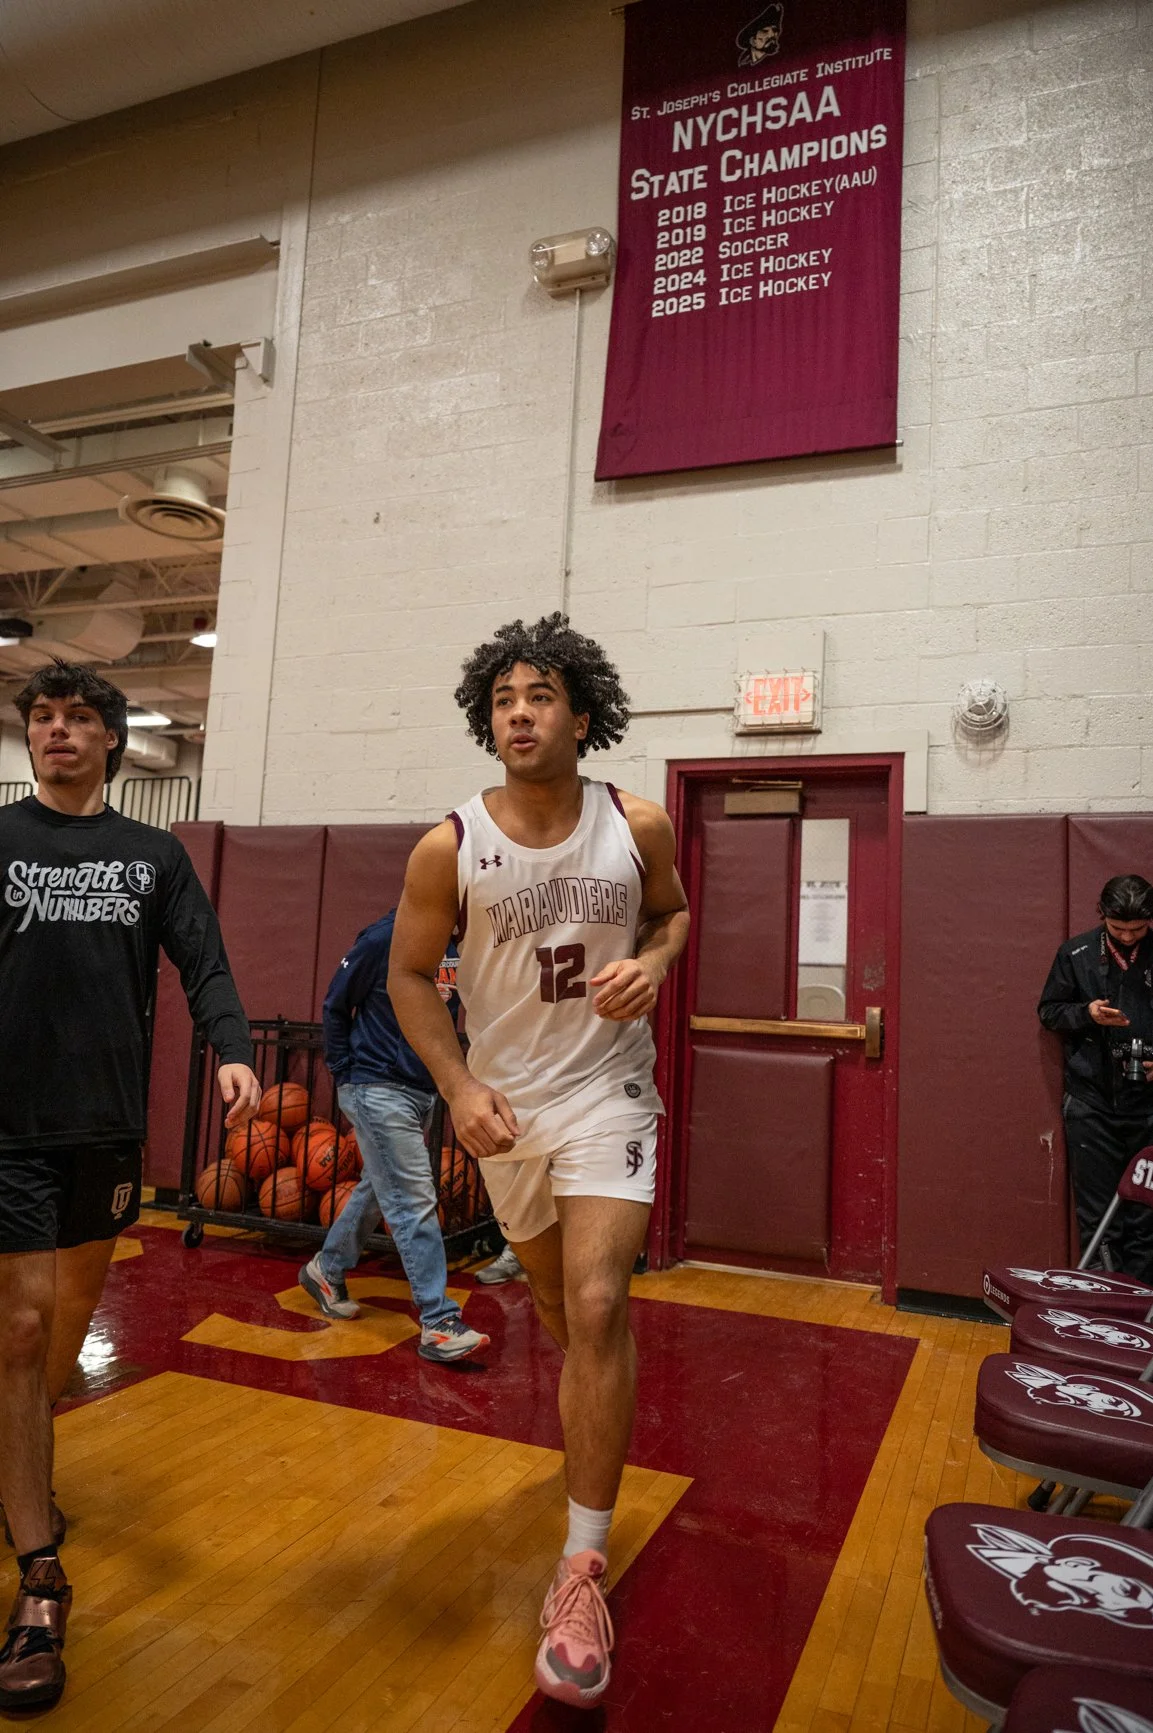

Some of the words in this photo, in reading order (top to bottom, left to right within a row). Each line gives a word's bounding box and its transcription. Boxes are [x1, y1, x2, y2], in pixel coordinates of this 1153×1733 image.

[631, 106, 650, 120] ST.
[657, 90, 721, 116] JOSEPH'S
[727, 69, 808, 98] COLLEGIATE
[816, 48, 892, 78] INSTITUTE
[672, 85, 841, 152] NYCHSAA
[630, 165, 708, 200] STATE
[720, 124, 887, 183] CHAMPIONS
[656, 224, 706, 249] 2019
[722, 216, 756, 236] ICE
[762, 201, 835, 228] HOCKEY
[657, 202, 707, 227] 2018
[723, 193, 756, 214] ICE
[653, 269, 707, 295] 2024
[720, 262, 753, 282] ICE
[760, 248, 832, 275] HOCKEY
[654, 247, 704, 272] 2022
[718, 233, 789, 259] SOCCER
[651, 292, 705, 318] 2025
[719, 286, 752, 306] ICE
[759, 272, 832, 299] HOCKEY
[753, 676, 803, 715] EXIT
[5, 860, 124, 907] Strength
[13, 889, 23, 900] in
[17, 887, 140, 933] NUMBERS
[486, 877, 628, 948] MARAUDERS
[536, 943, 586, 1003] 12
